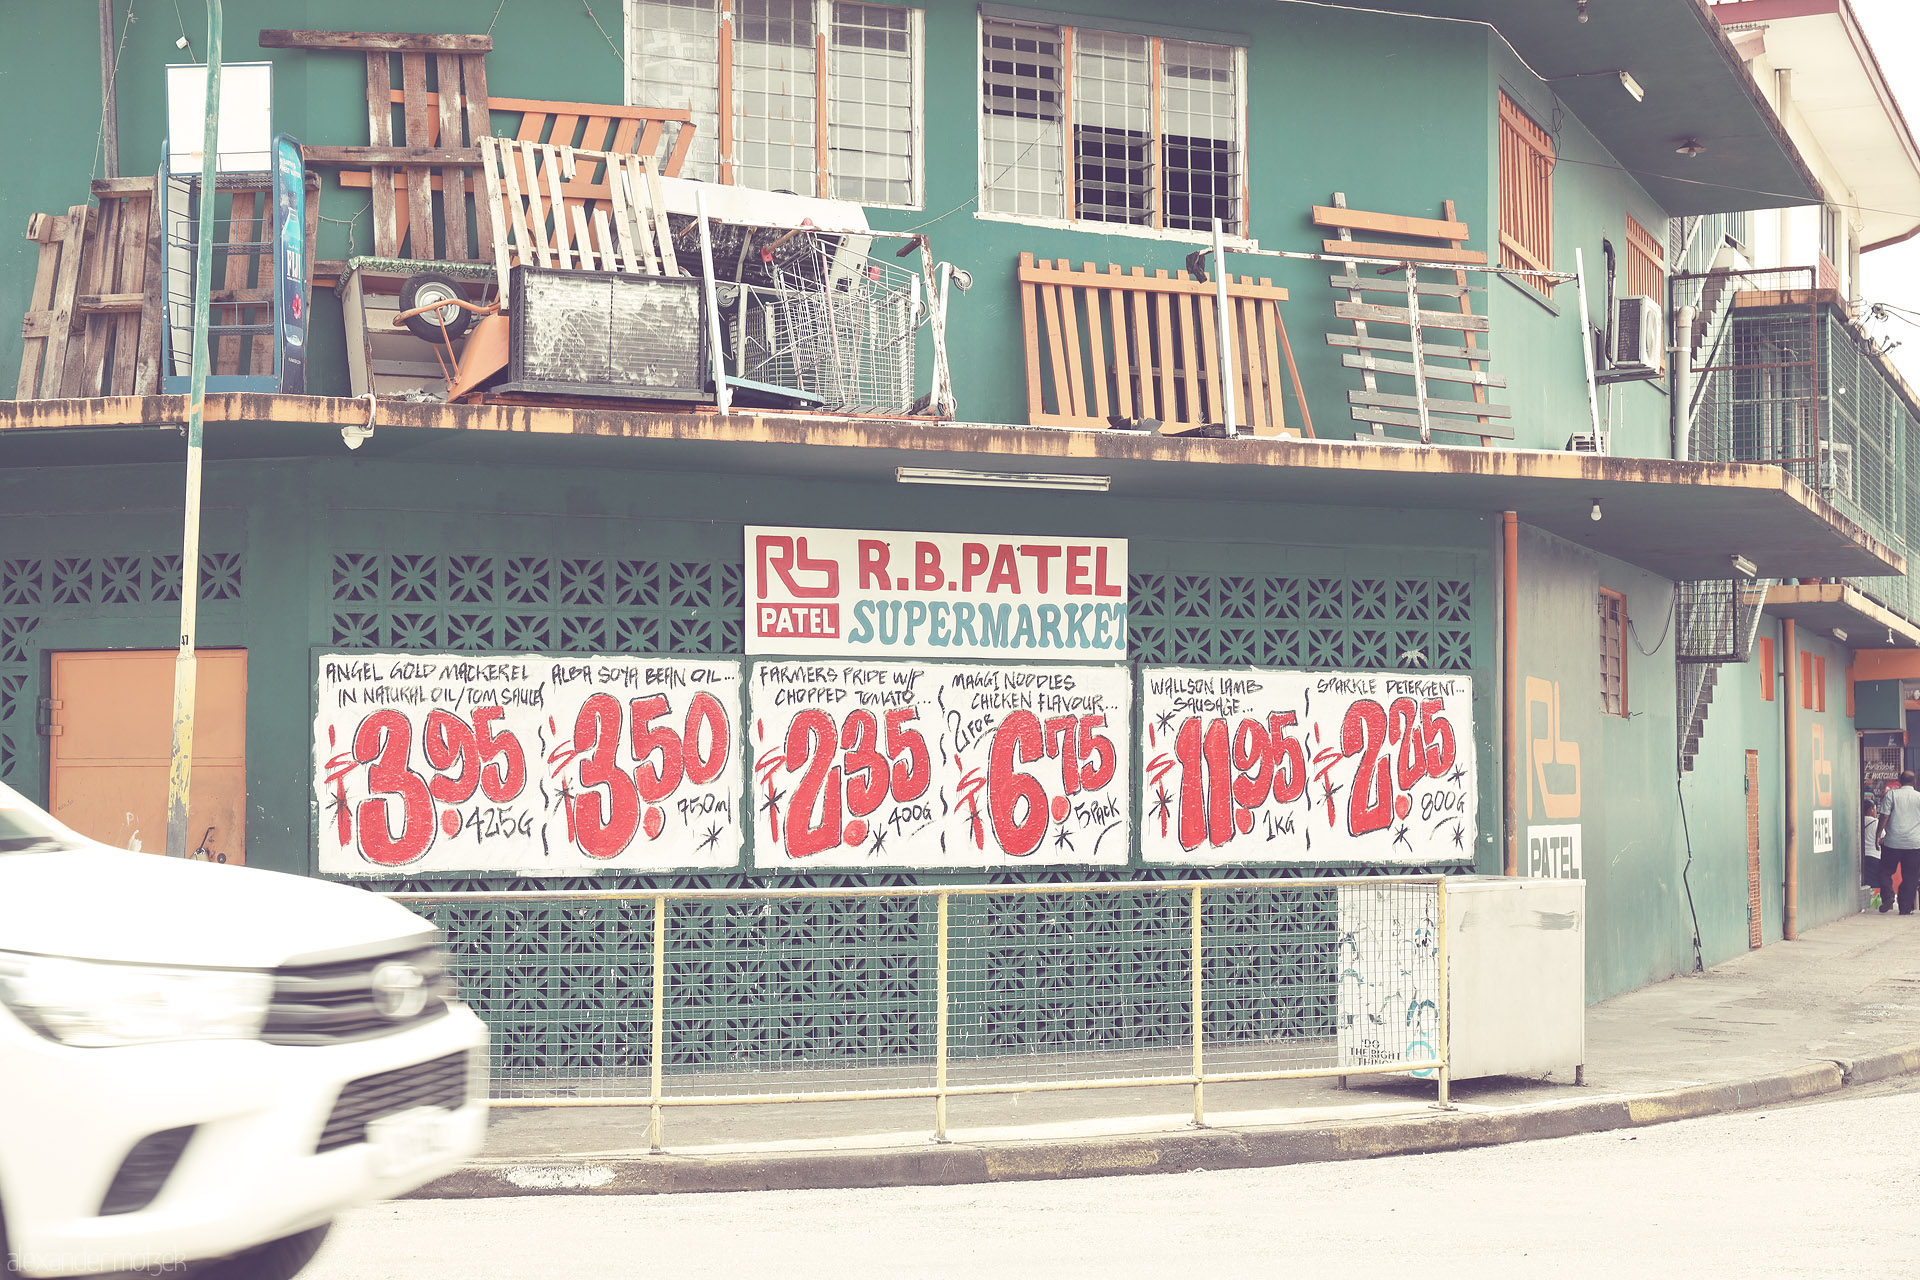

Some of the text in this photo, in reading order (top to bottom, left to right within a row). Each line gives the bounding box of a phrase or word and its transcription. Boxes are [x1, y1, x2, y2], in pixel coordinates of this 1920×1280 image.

[286, 249, 302, 279] FIJI
[761, 607, 836, 635] PATEL
[848, 599, 1128, 651] SUPERMARKET
[326, 661, 531, 684] ANGEL GOLD MACKEREL
[551, 663, 593, 686] ALBA
[598, 665, 638, 690] SOYA
[645, 665, 687, 690] BEAN
[760, 665, 838, 688] FARMERS
[843, 666, 888, 686] PRIDE
[952, 670, 1077, 692] MAGGI NOODLES
[1317, 676, 1377, 696] SPARKLE
[338, 687, 357, 708] IN
[363, 685, 429, 706] NATURAL
[774, 687, 848, 706] CHOPPED
[971, 691, 1033, 710] CHICKEN
[1150, 676, 1264, 699] WALLSON LAMB
[888, 803, 932, 835] 400G
[1421, 790, 1467, 821] 800G
[465, 804, 534, 844] 425G
[1263, 810, 1295, 841] 1KG
[1814, 817, 1831, 846] PATEL
[1530, 836, 1580, 880] PATEL
[1350, 1047, 1368, 1058] THE
